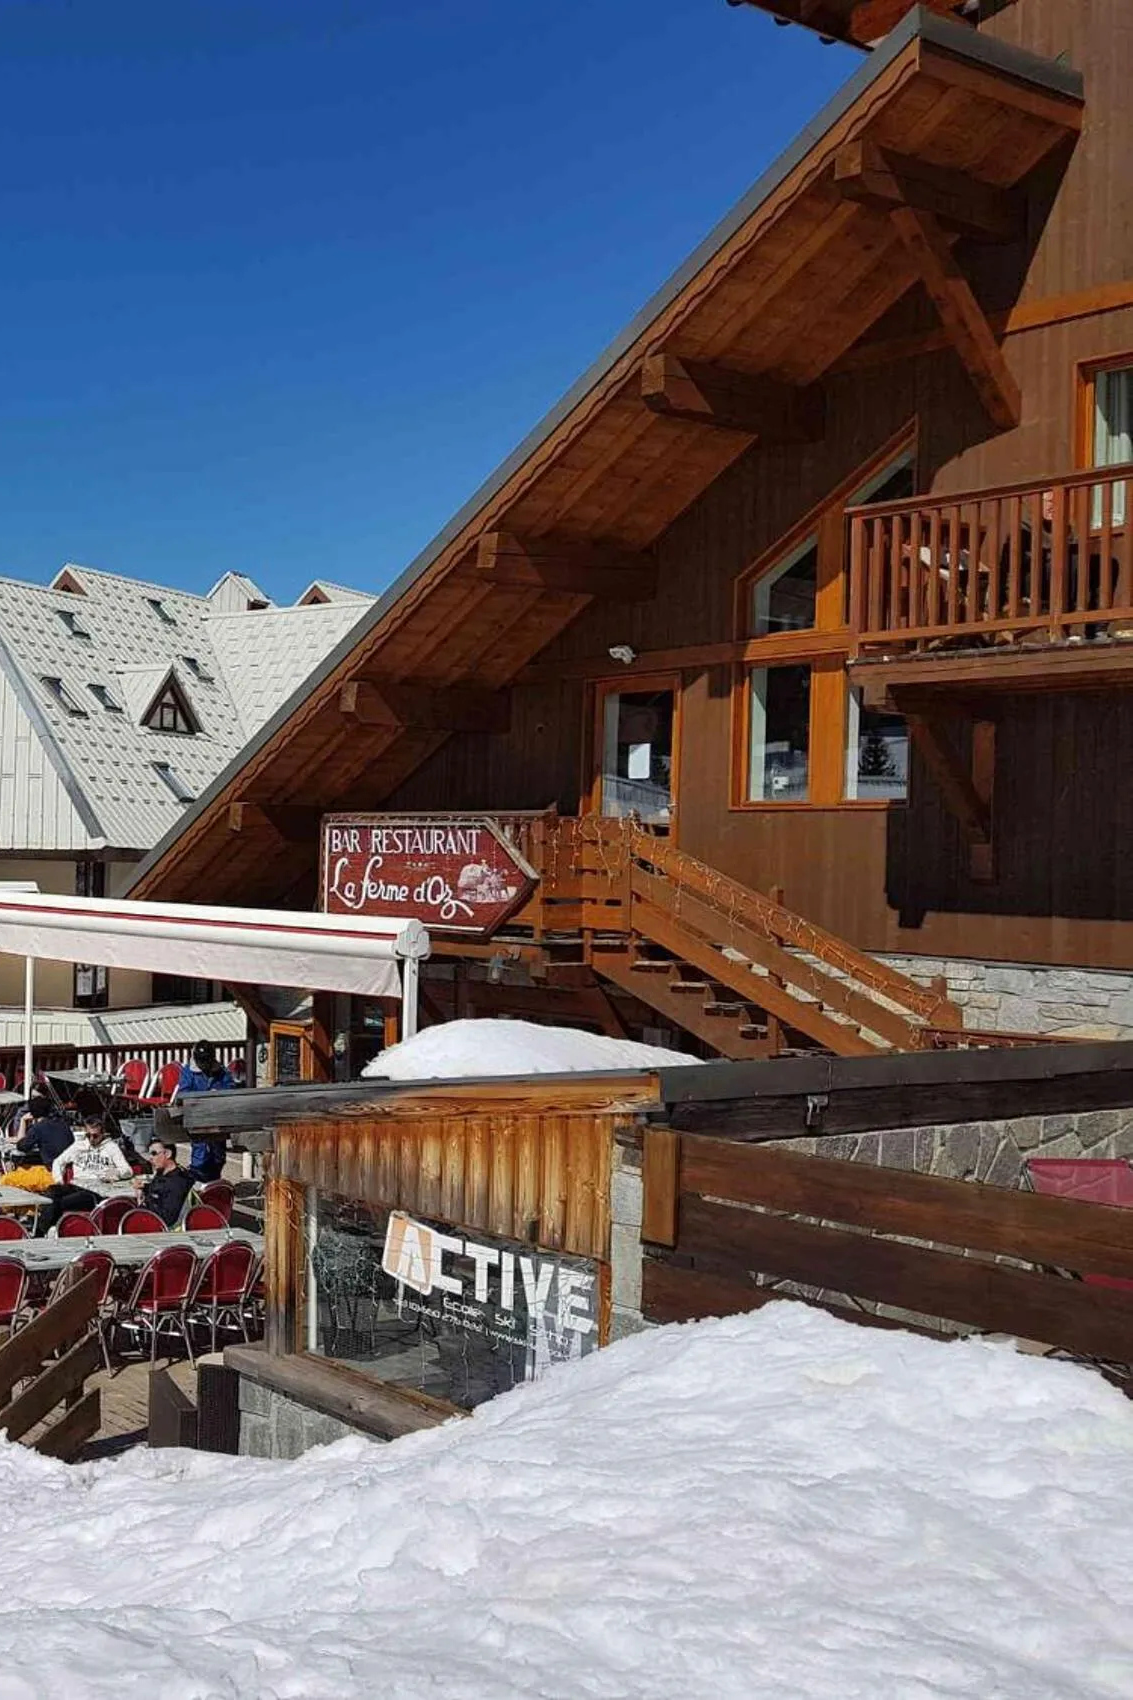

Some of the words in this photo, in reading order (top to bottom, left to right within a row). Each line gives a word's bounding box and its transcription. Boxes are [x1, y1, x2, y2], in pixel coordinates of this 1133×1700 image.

[332, 829, 361, 853] BAR
[371, 829, 481, 856] RESTAURANT
[384, 1212, 596, 1335] ACTIVE
